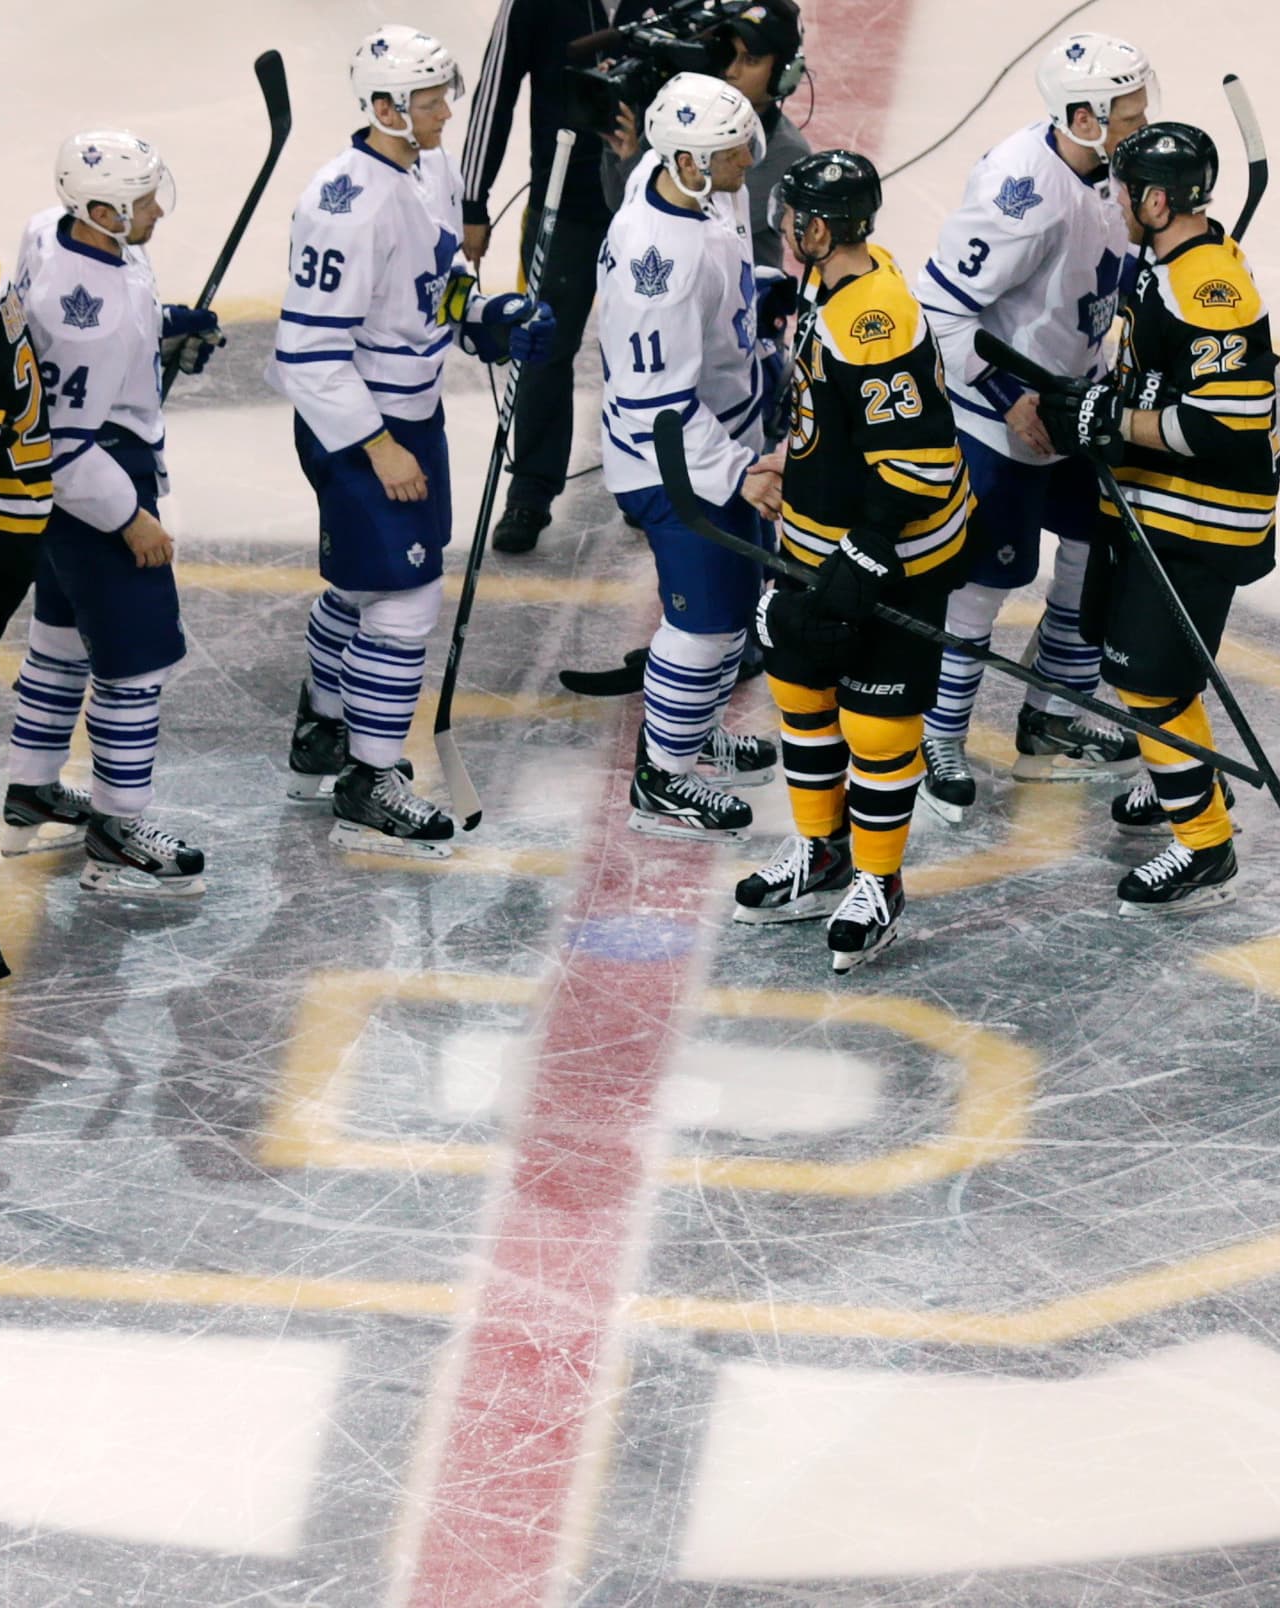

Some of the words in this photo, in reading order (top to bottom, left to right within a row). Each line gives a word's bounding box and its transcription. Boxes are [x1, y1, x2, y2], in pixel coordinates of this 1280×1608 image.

[294, 245, 345, 293] 36
[958, 238, 990, 277] 3
[629, 329, 665, 373] 11
[1190, 334, 1248, 380] 22
[40, 361, 90, 409] 24
[860, 370, 923, 425] 23
[1139, 368, 1164, 411] ebok
[1078, 383, 1110, 448] Reebok
[838, 675, 906, 695] BAUER
